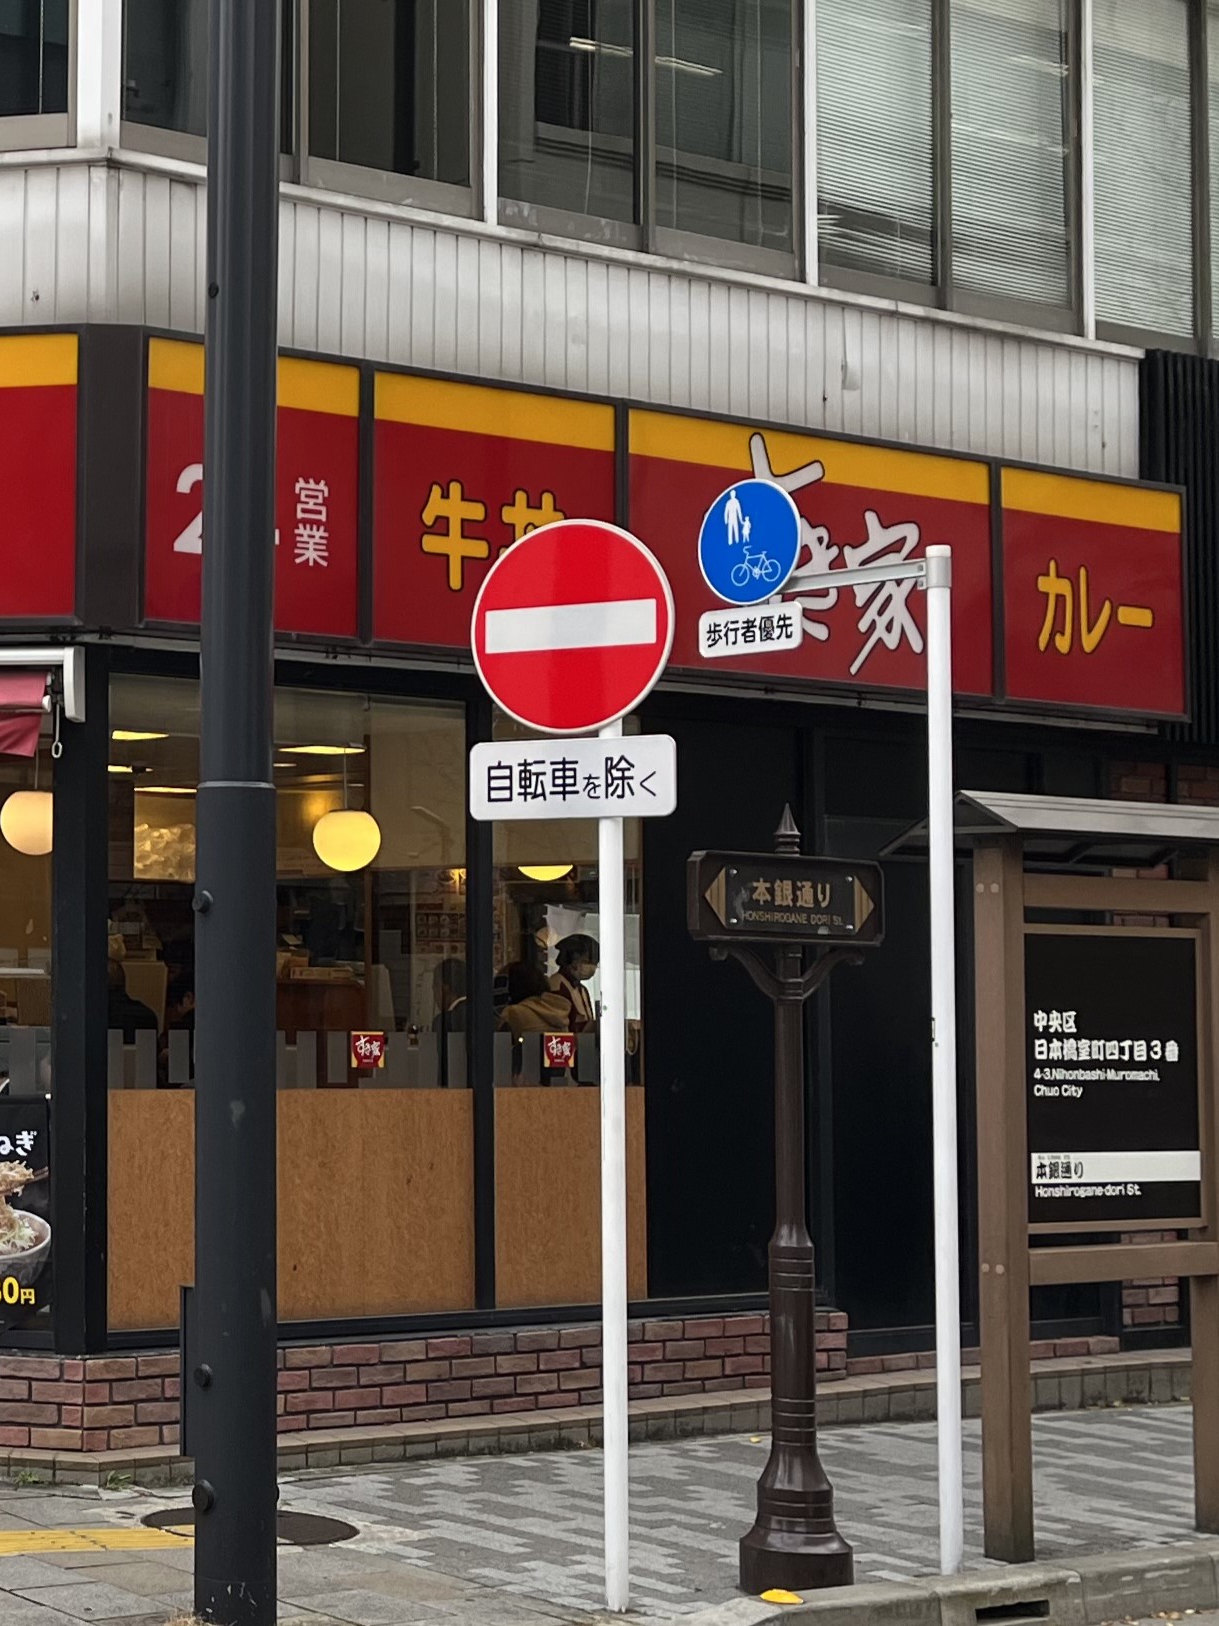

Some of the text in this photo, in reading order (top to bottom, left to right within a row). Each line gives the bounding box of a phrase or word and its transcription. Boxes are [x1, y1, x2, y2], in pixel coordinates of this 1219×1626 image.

[293, 476, 329, 569] 営業
[1036, 558, 1155, 656] カレー
[705, 613, 794, 649] 歩行者優先
[486, 755, 658, 803] 自転車を除く
[752, 877, 830, 908] 本銀通り
[810, 913, 831, 925] DORI
[1033, 1009, 1078, 1033] 中央区
[355, 1034, 381, 1059] すき家
[547, 1035, 571, 1059] すき家
[1033, 1084, 1084, 1098] Chuo City
[1036, 1161, 1084, 1180] 本銀通り
